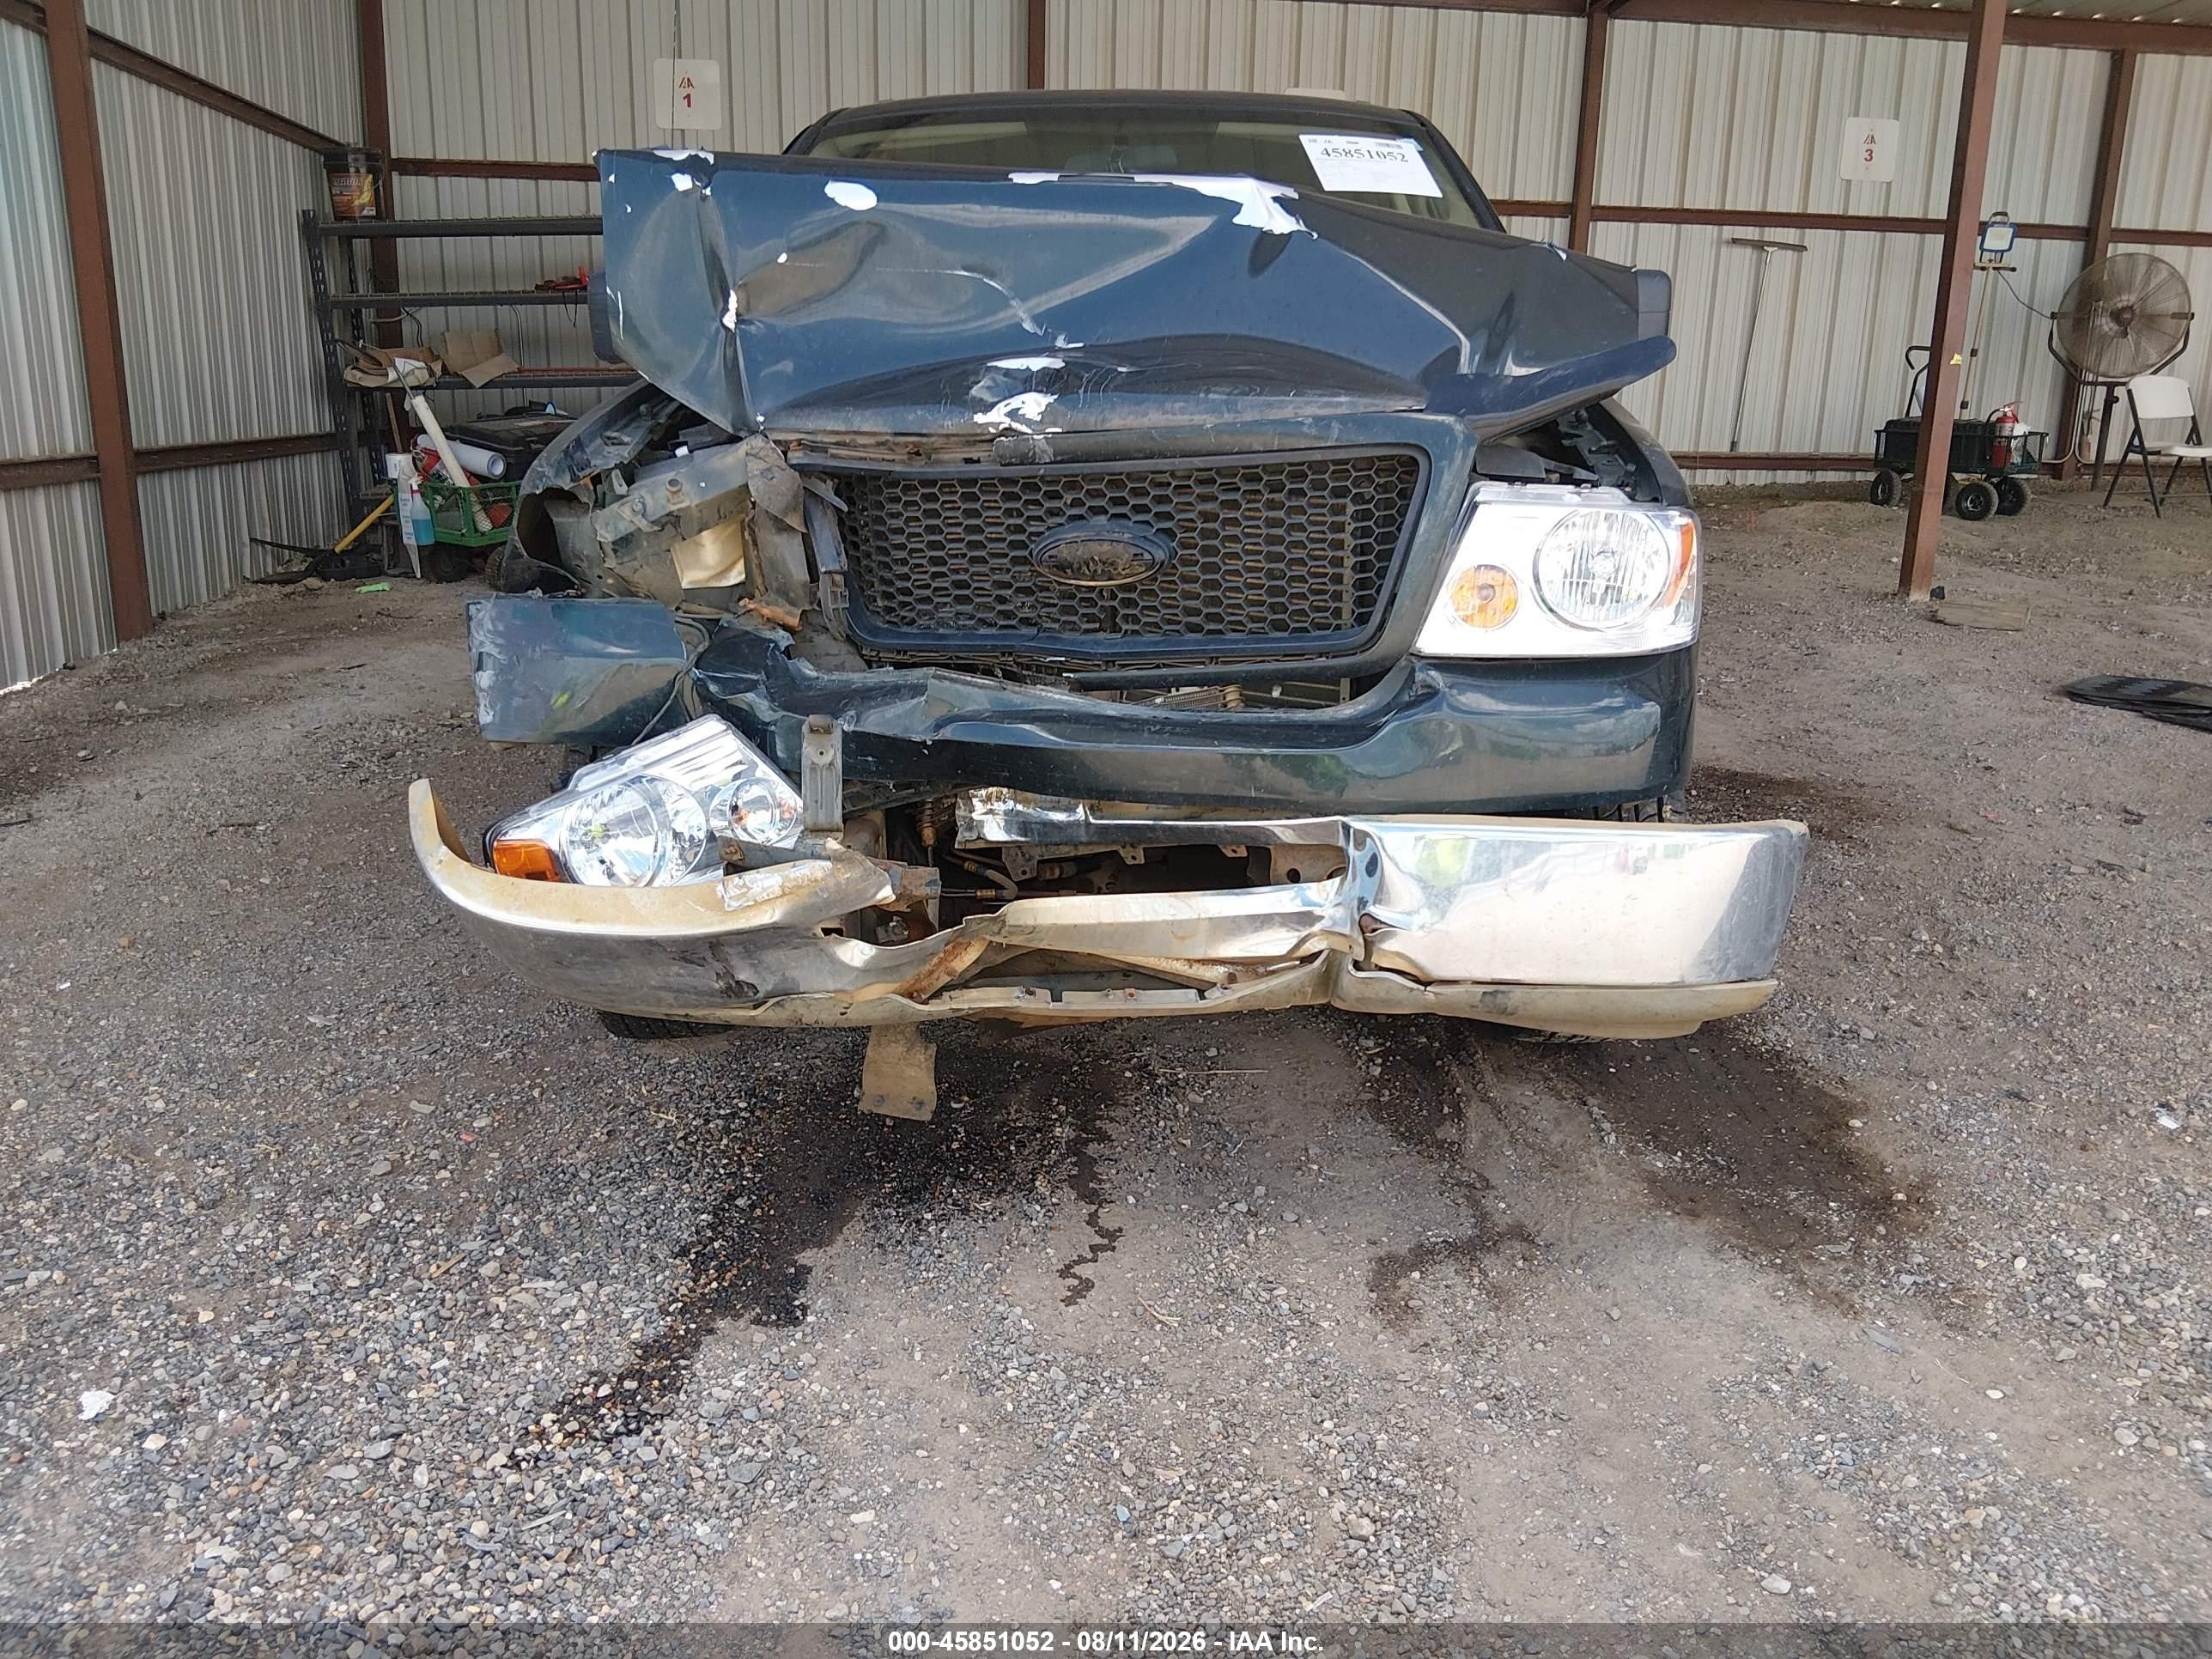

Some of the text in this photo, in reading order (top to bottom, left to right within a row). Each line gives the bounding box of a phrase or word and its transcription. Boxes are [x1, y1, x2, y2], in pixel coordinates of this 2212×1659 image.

[683, 93, 692, 108] 1
[1320, 147, 1409, 162] 45851052
[1864, 149, 1874, 162] 3
